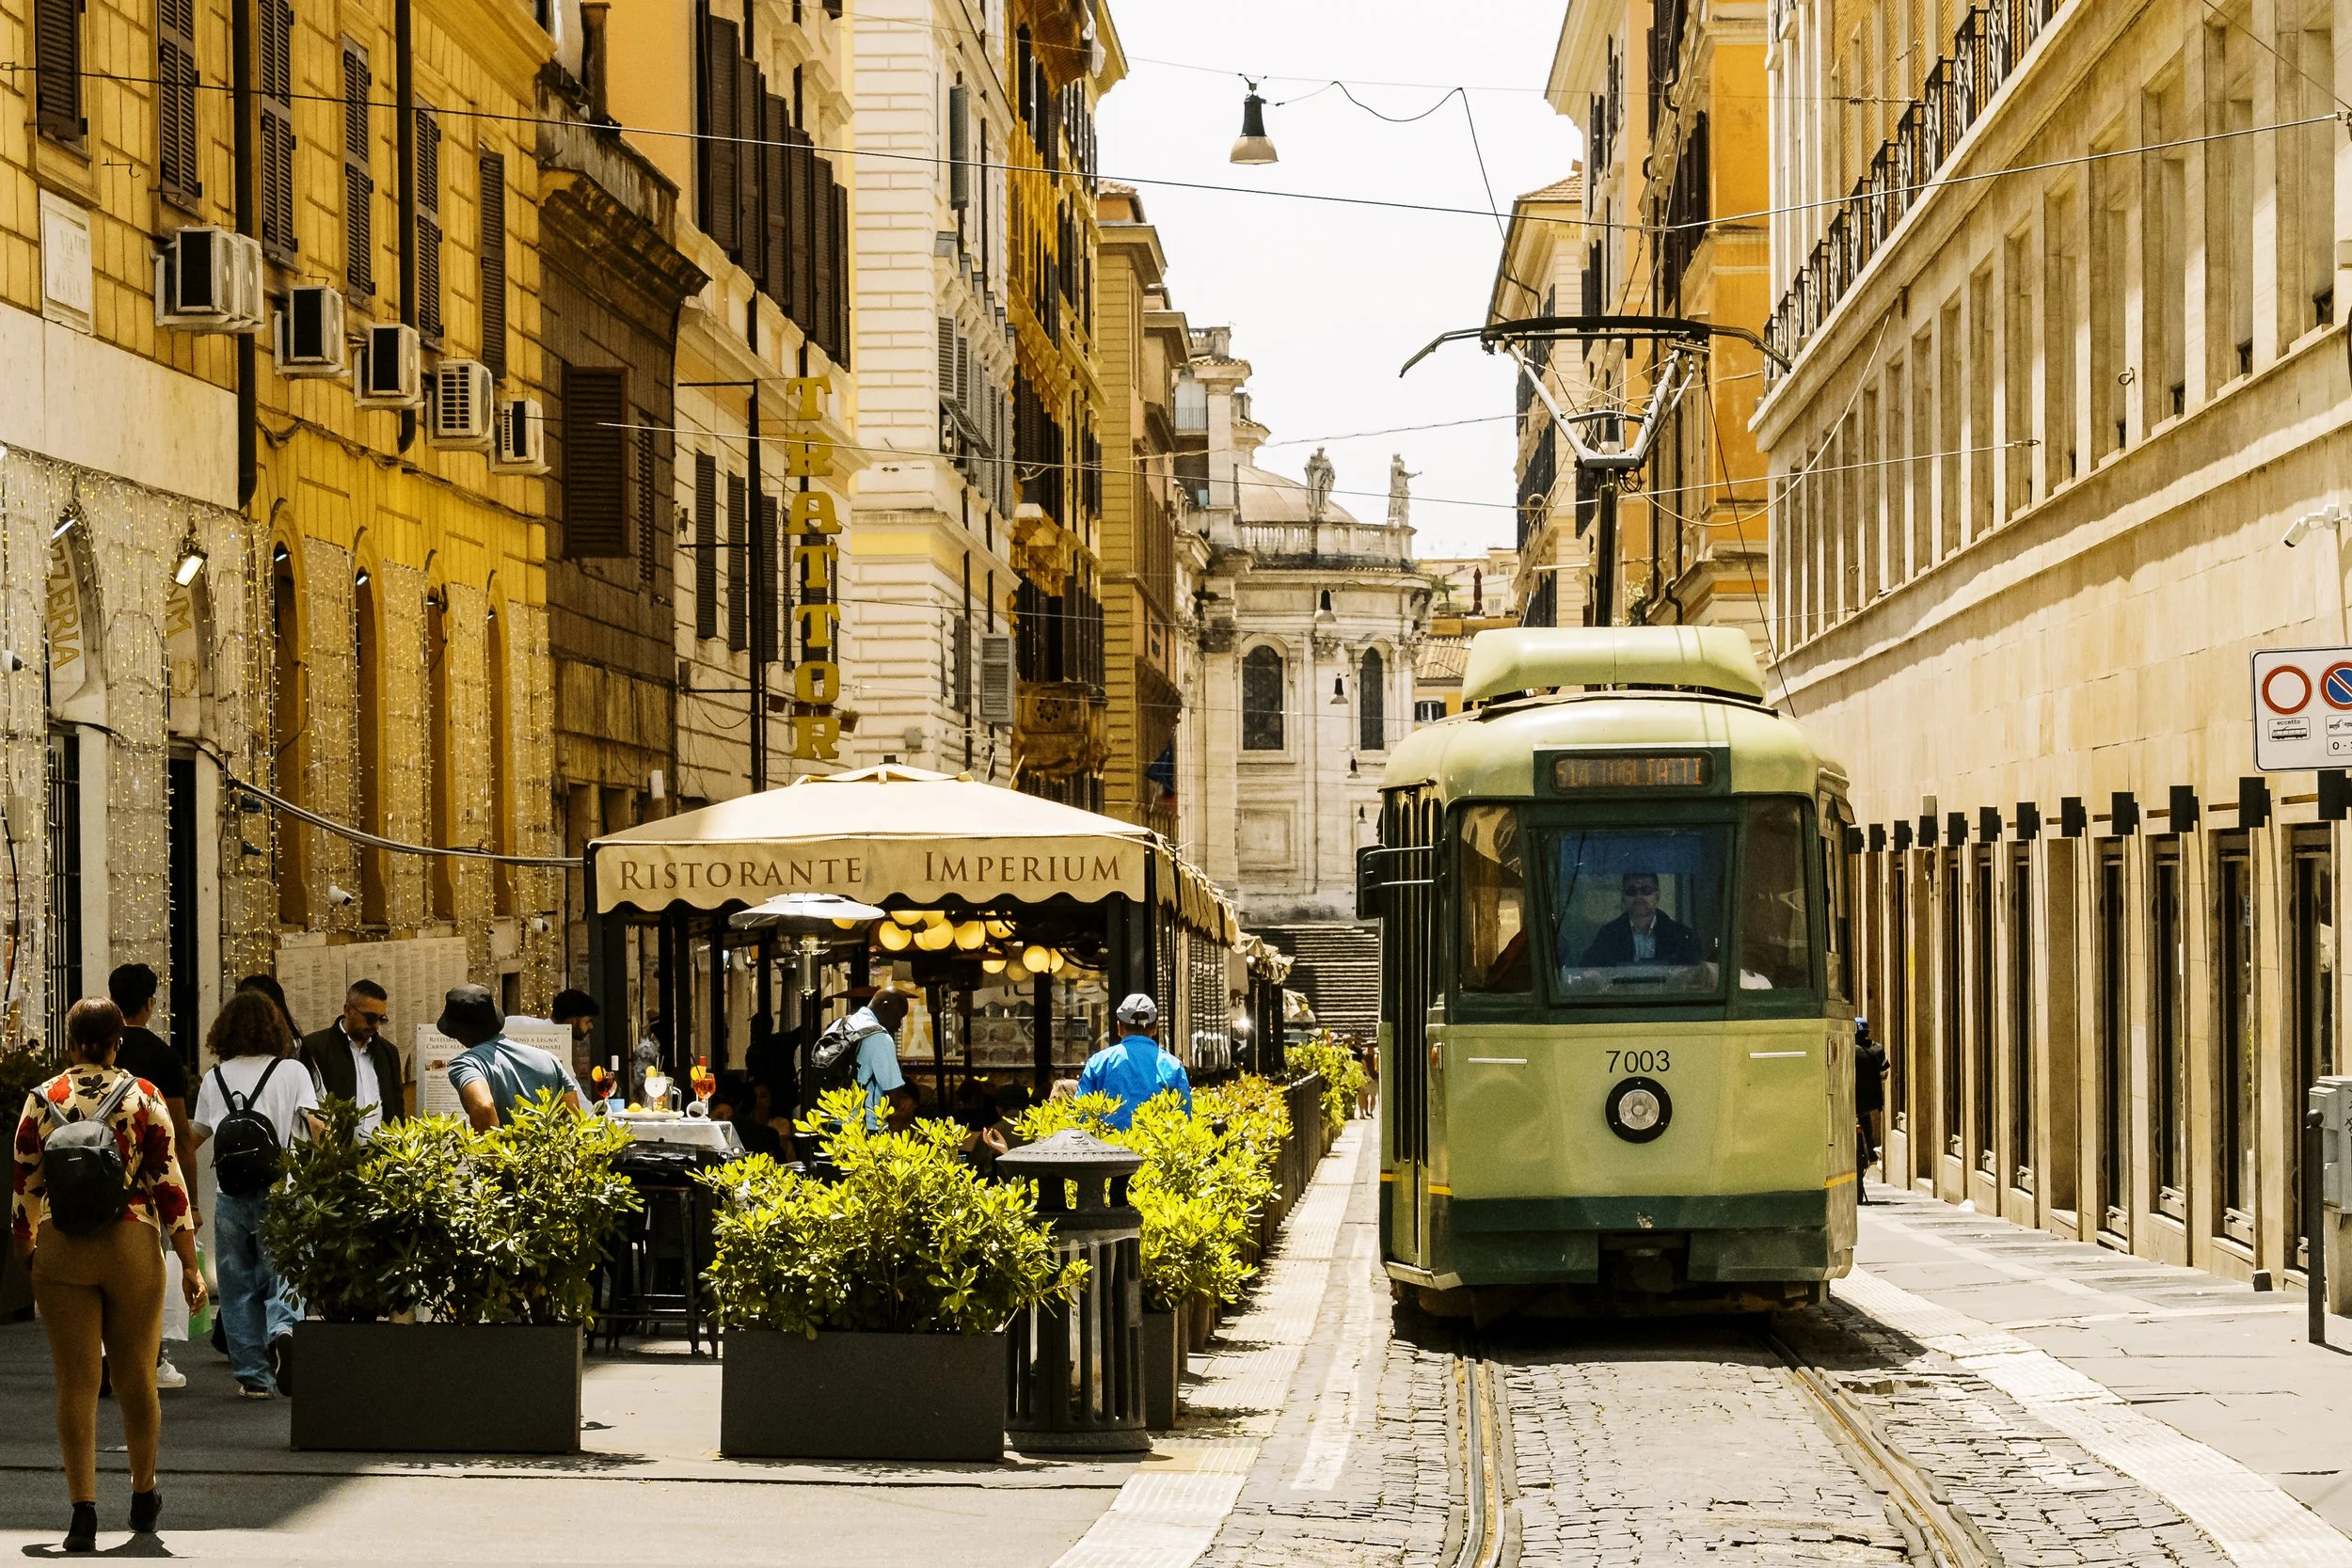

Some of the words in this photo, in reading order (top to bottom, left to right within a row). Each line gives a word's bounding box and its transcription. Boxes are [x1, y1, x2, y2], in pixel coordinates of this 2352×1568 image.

[620, 858, 863, 890] RISTORANTE
[926, 851, 1121, 881] IMPERIUM
[1605, 1050, 1671, 1073] 7003
